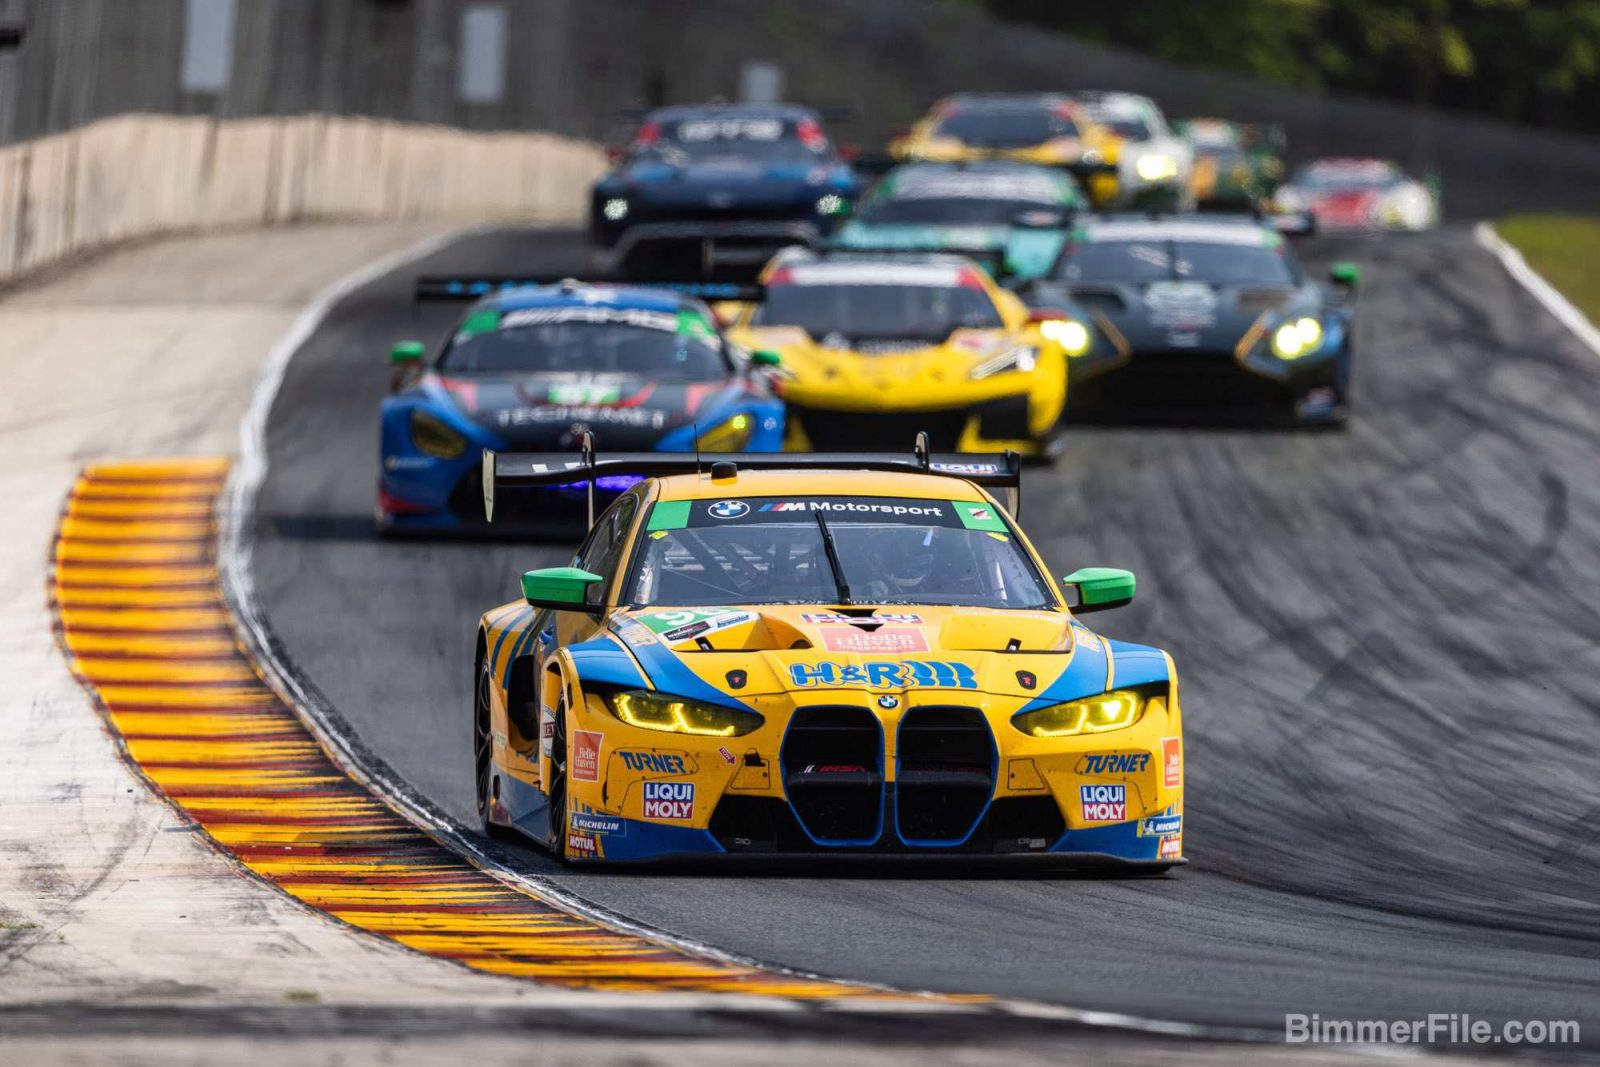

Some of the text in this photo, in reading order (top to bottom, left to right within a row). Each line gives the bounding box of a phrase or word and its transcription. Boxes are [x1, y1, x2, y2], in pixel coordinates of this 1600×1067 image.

[810, 502, 942, 517] Motorsport
[790, 661, 913, 689] H&R
[619, 751, 686, 774] TURNER
[1085, 754, 1149, 774] TURNER
[645, 783, 692, 800] LIQUI
[1082, 786, 1124, 802] LIQUI
[645, 801, 692, 817] MOLY
[1084, 803, 1125, 819] MOLY
[578, 819, 619, 831] MICHELIN
[570, 835, 595, 850] MOTUL
